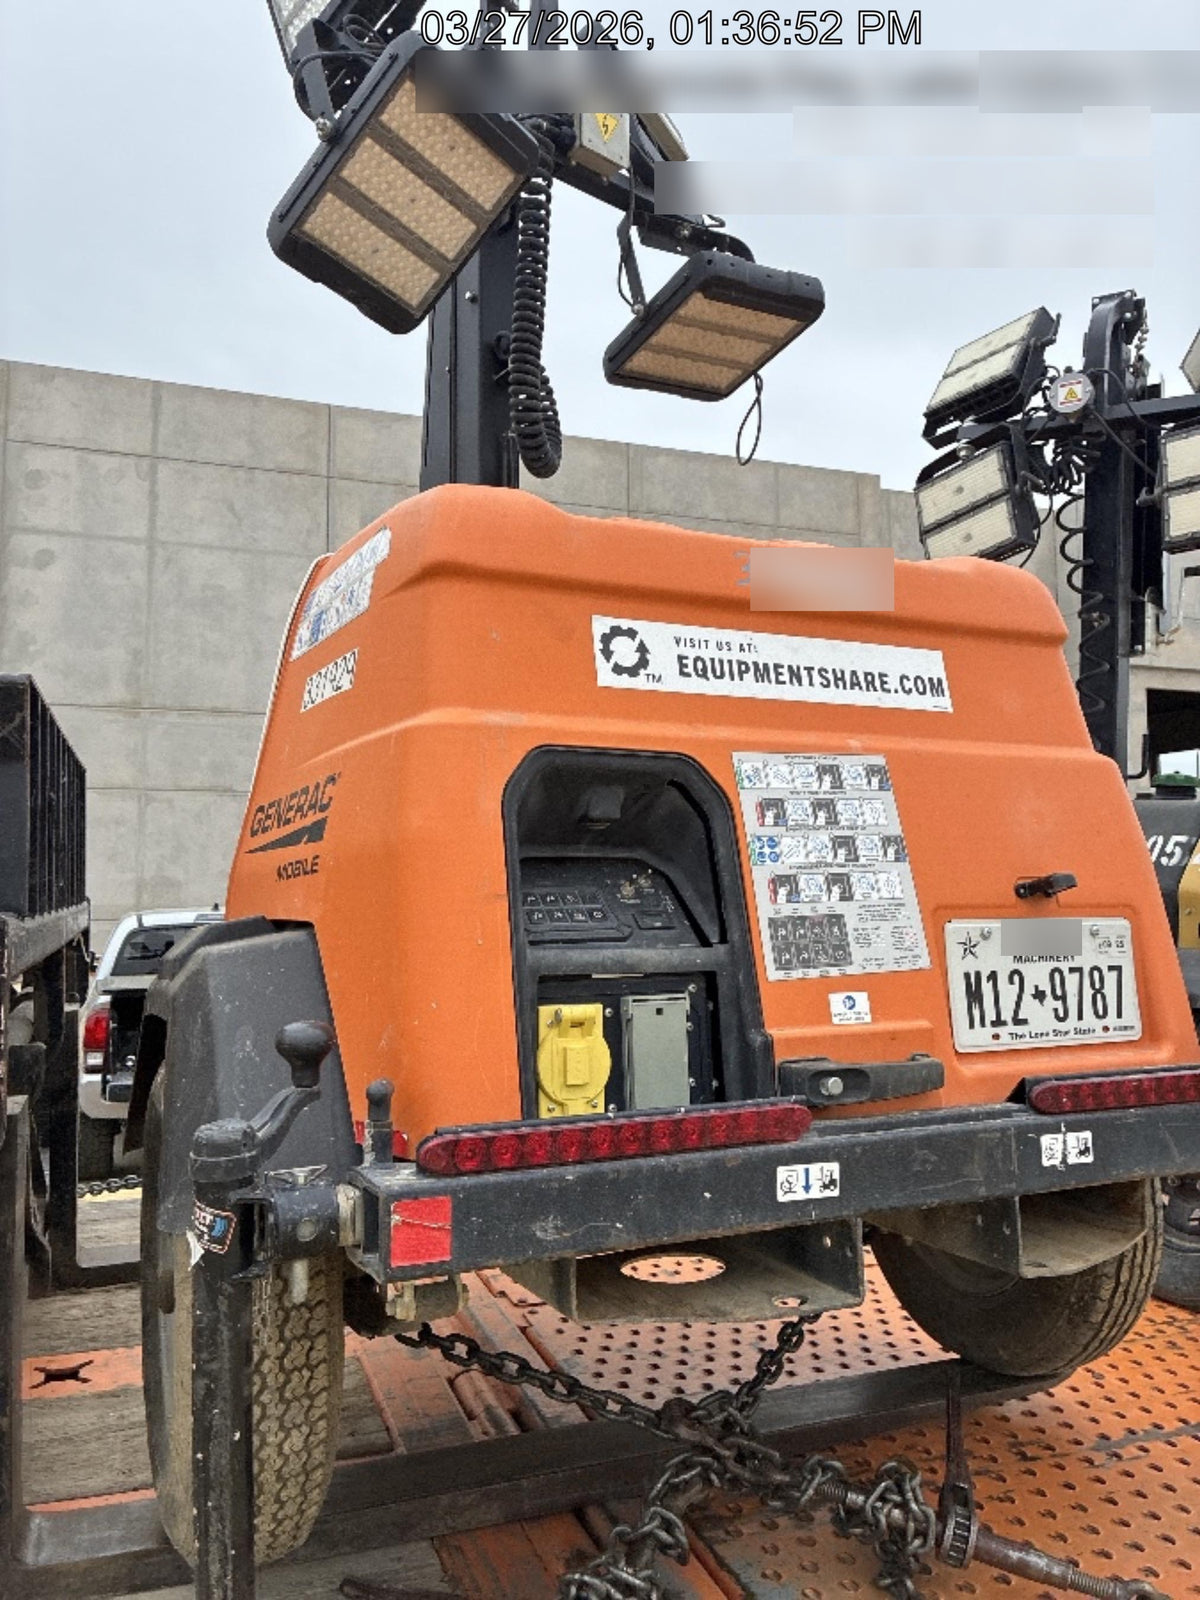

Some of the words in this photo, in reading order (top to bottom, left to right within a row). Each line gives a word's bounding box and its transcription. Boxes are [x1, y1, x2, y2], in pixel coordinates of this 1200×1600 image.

[673, 636, 710, 650] VISIT
[716, 641, 732, 652] US
[677, 654, 946, 698] EQUIPMENTSHARE.COM
[250, 774, 337, 838] GENERAC
[275, 855, 320, 882] MOBILE
[963, 968, 1029, 1030] M12
[1049, 965, 1123, 1023] 9787
